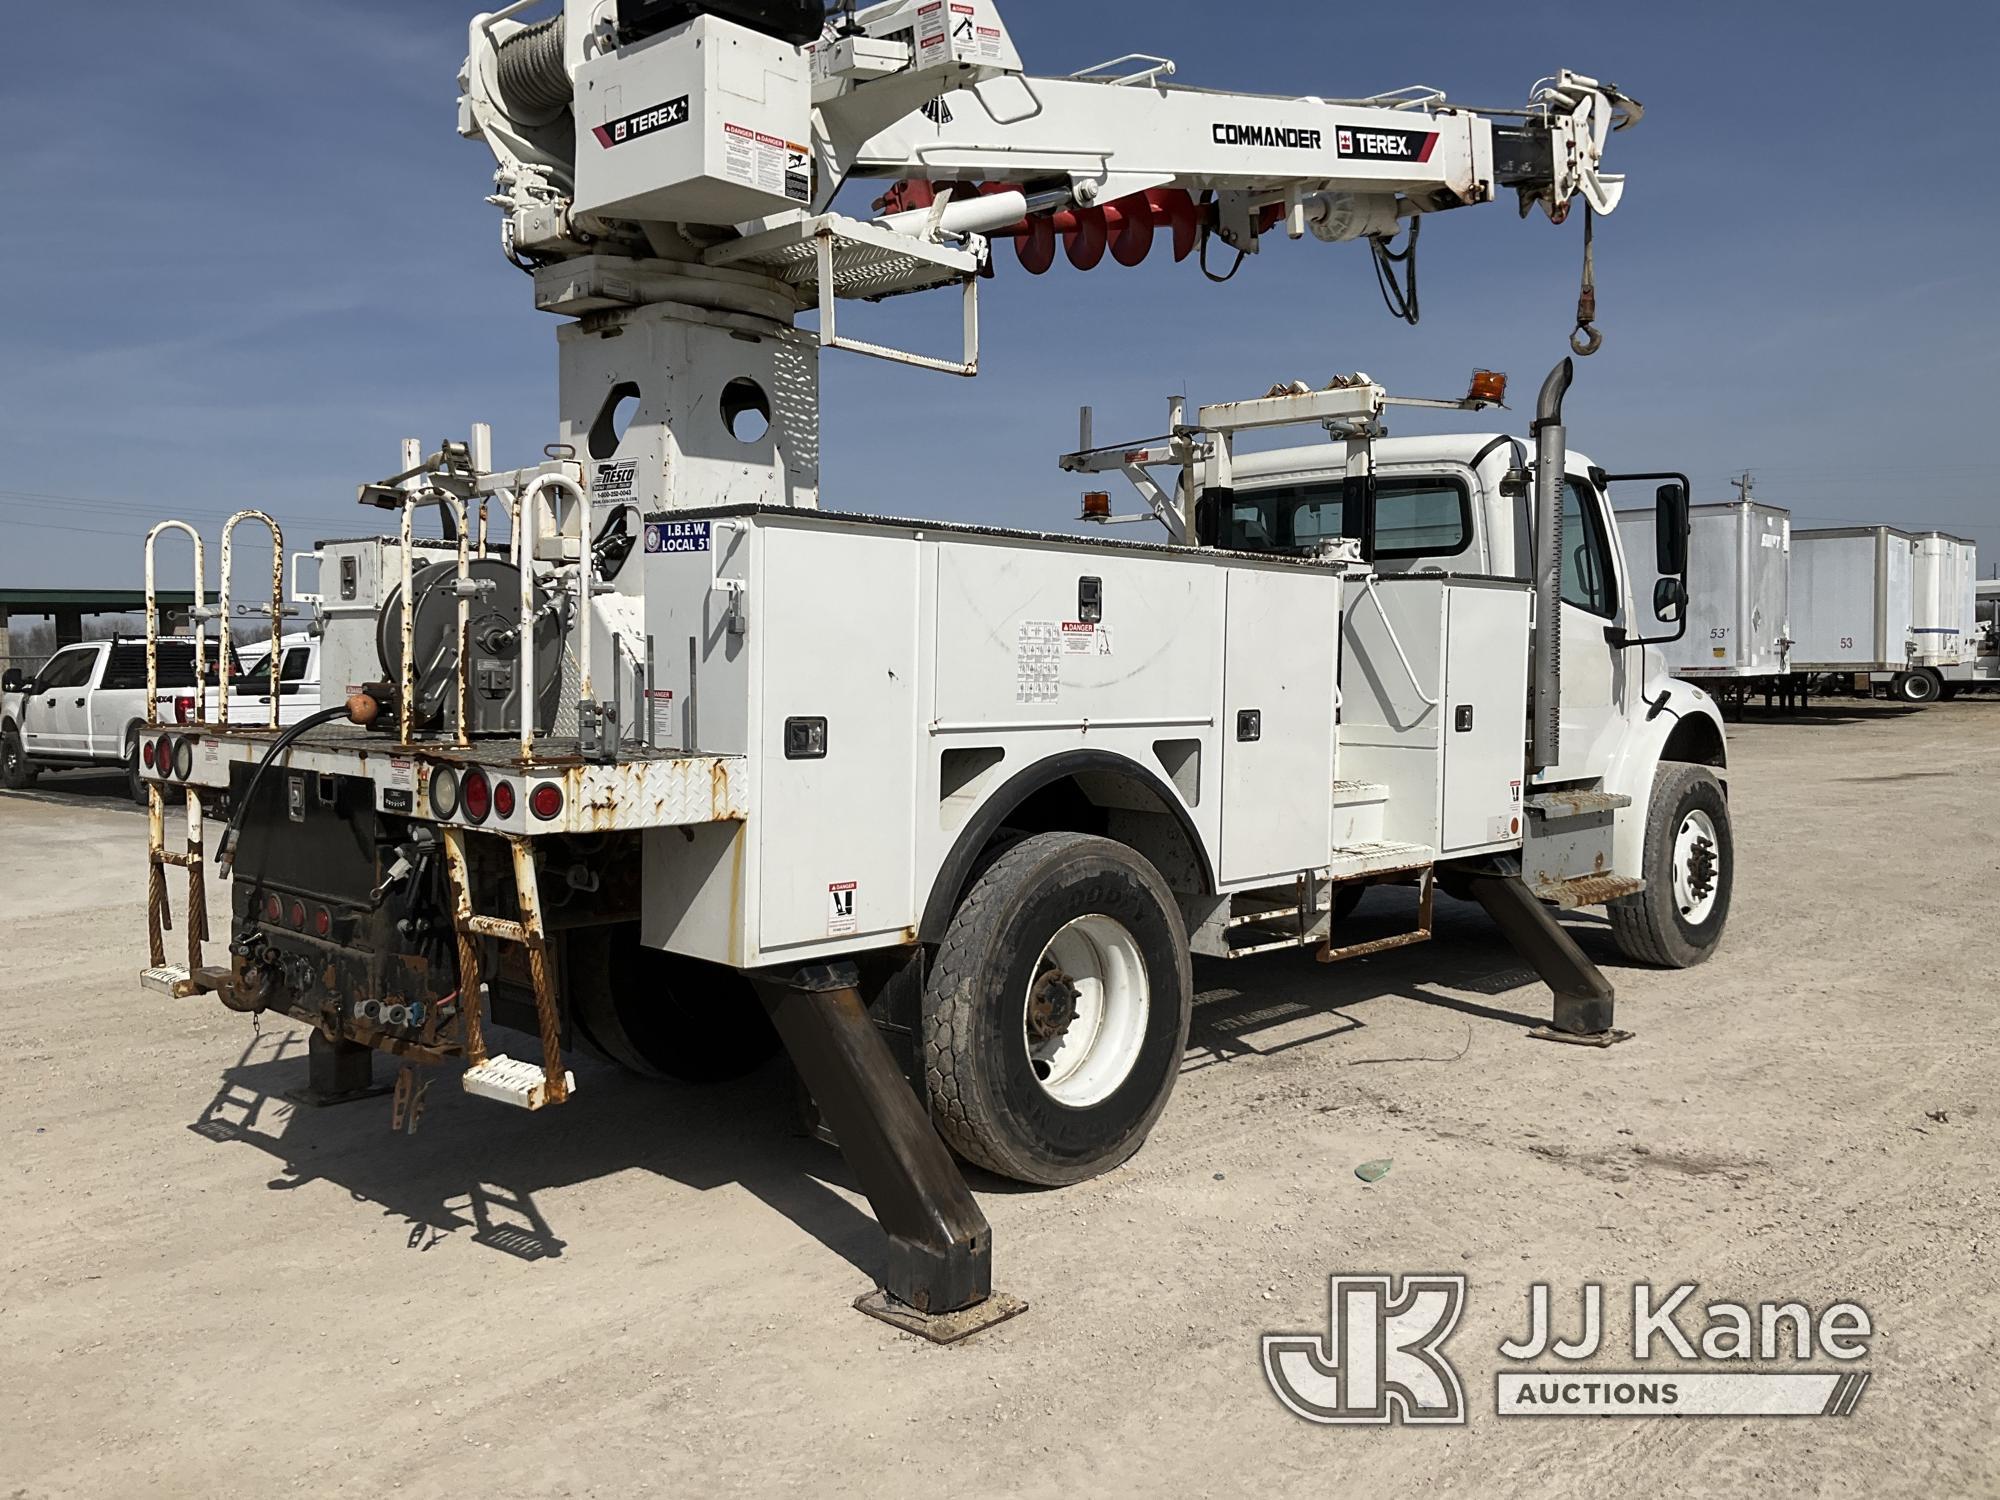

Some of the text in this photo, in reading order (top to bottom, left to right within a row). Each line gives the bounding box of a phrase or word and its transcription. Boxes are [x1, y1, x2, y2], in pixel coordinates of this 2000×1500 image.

[630, 103, 678, 134] TEREX
[730, 126, 753, 139] DANGER
[1212, 123, 1322, 149] COMMANDER
[760, 134, 784, 147] DANGER
[1356, 133, 1409, 156] TEREX
[667, 523, 706, 537] I.B.E.W.
[662, 538, 710, 551] LOCAL 51
[1068, 623, 1093, 632] DANGER
[1710, 628, 1730, 639] 53'
[1840, 637, 1853, 649] 53
